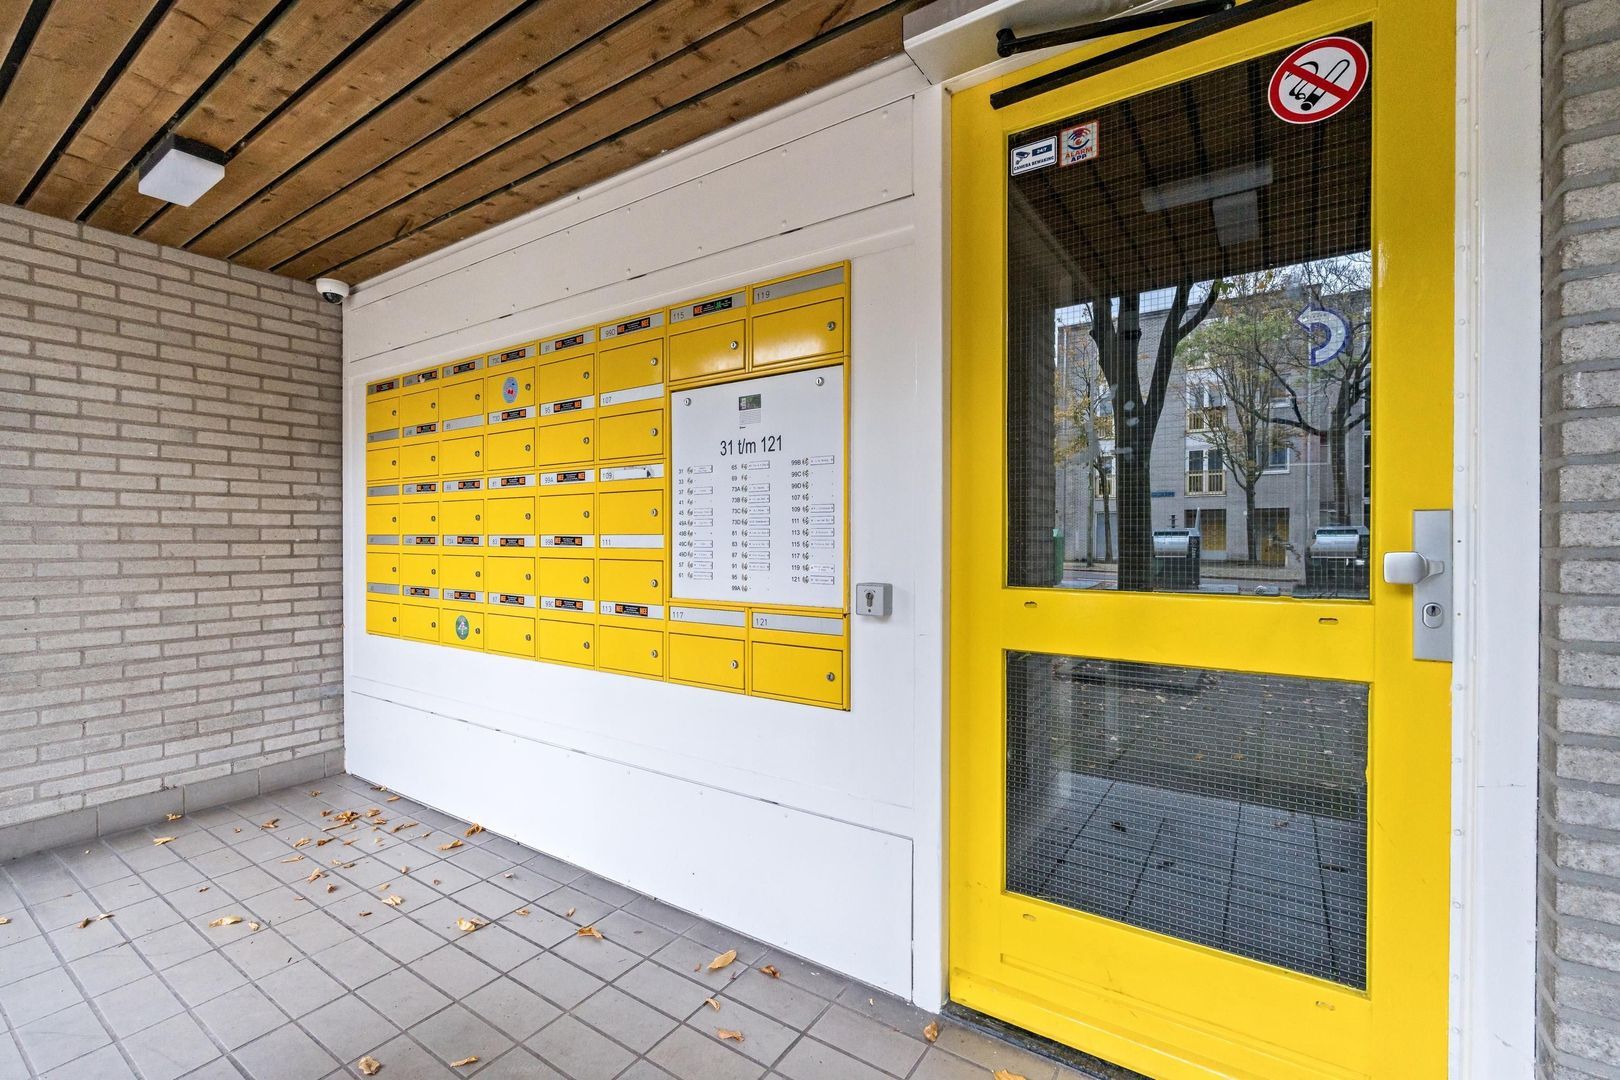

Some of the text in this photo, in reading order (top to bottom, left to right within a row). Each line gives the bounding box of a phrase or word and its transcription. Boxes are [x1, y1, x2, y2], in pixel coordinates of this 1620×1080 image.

[1065, 146, 1093, 159] ALARM
[1070, 154, 1087, 162] APP
[1013, 155, 1054, 171] CAMERA BEWAKING
[756, 291, 770, 300] 119
[673, 312, 685, 320] 115
[602, 396, 612, 405] 107
[720, 434, 782, 456] 31 t/m 121
[602, 603, 612, 612] 113
[672, 611, 684, 619] 117
[756, 618, 768, 626] 121
